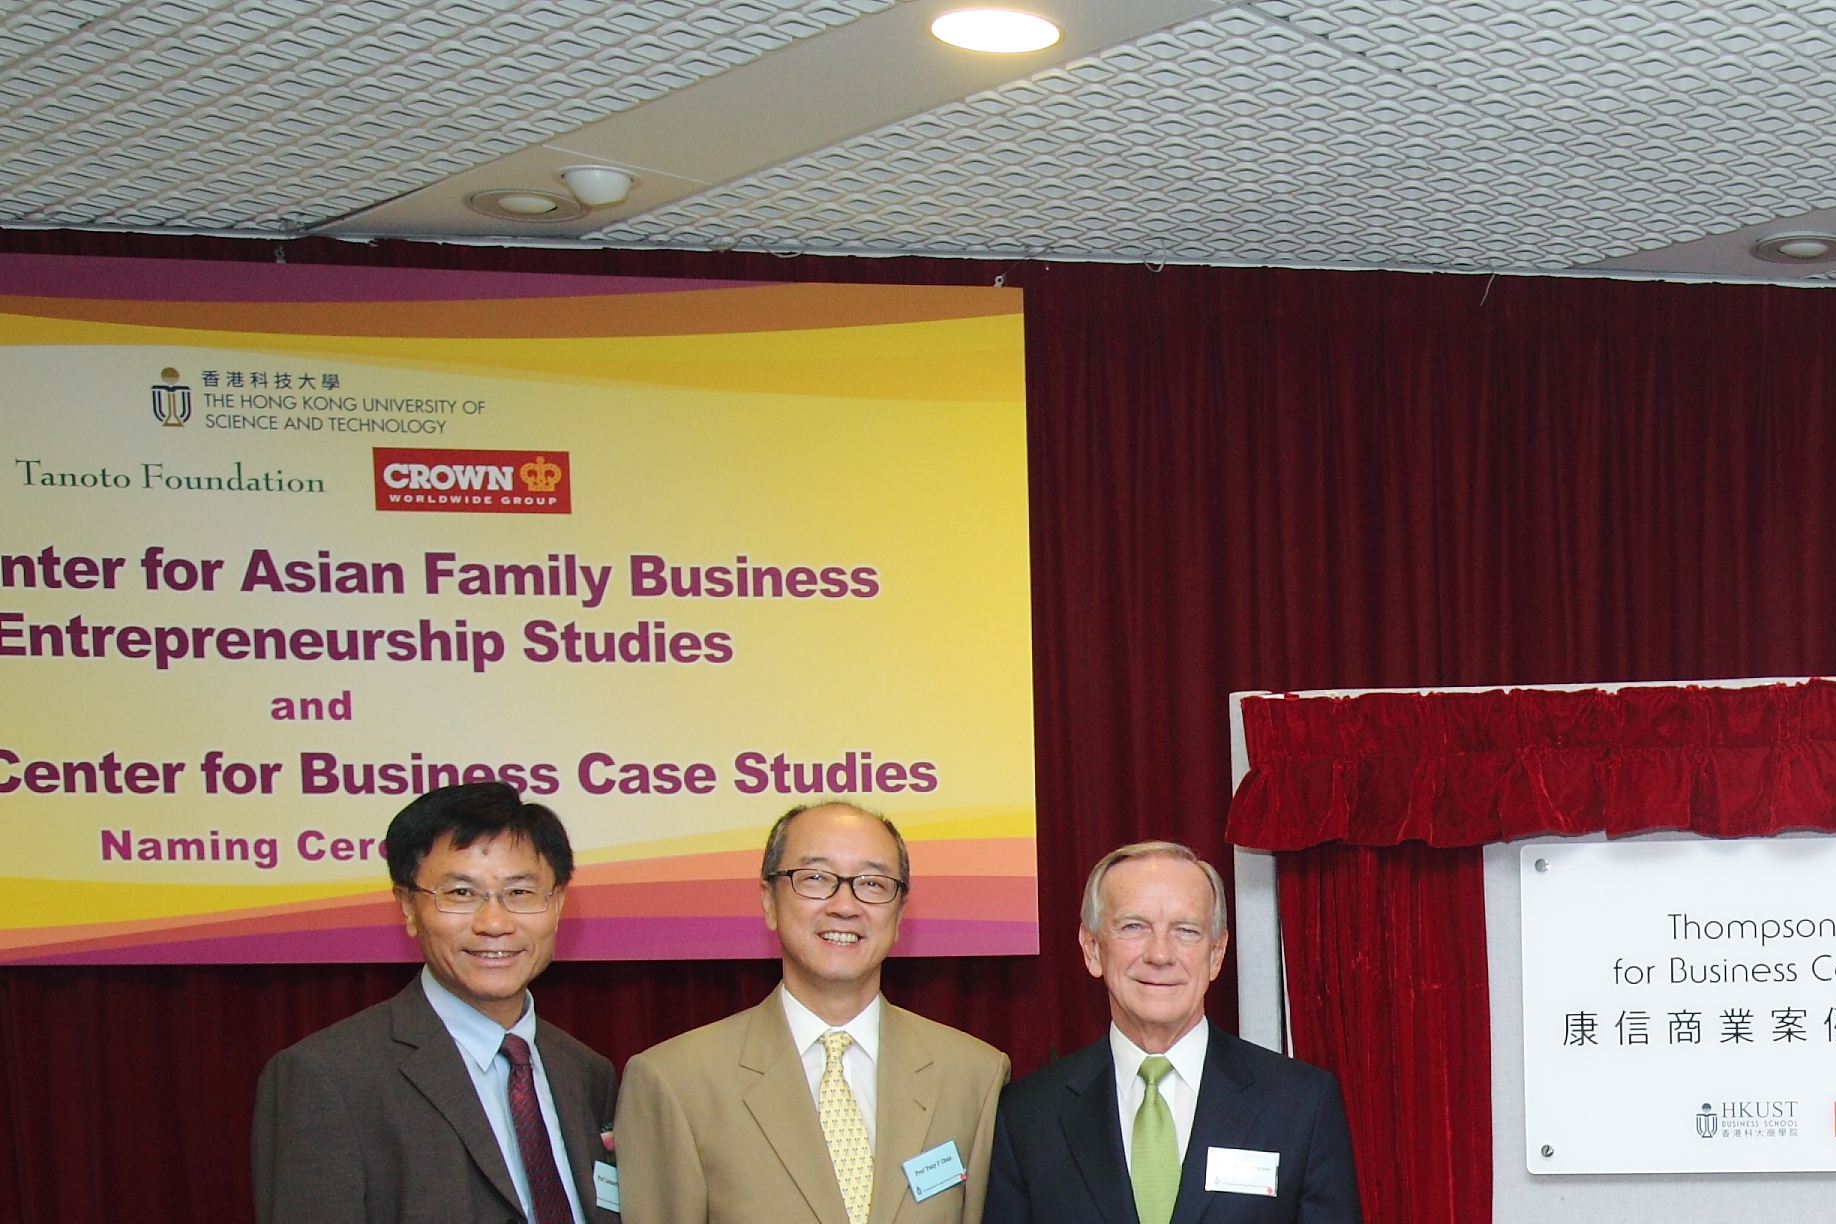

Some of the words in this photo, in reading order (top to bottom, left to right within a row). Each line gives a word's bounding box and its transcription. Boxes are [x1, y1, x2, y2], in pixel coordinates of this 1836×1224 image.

[202, 370, 340, 391] 香港科技大學
[203, 393, 234, 408] THE
[241, 394, 297, 410] HONG
[303, 396, 357, 412] KONG
[362, 398, 456, 414] UNIVERSITY
[464, 400, 485, 414] OF
[206, 414, 278, 430] SCIENCE
[284, 416, 323, 432] AND
[328, 418, 446, 434] TECHNOLOGY
[15, 459, 131, 489] Tanoto
[141, 462, 326, 494] Foundation
[383, 462, 514, 491] CROWN
[389, 494, 493, 505] WORLDWIDE
[501, 496, 557, 505] GROUP
[142, 546, 224, 592] for
[241, 549, 404, 595] Asian
[425, 552, 612, 607] Family
[630, 555, 880, 599] Business
[0, 612, 505, 674] Entrepreneurship
[523, 620, 733, 664] Studies
[270, 690, 353, 722] and
[202, 750, 283, 794] for
[301, 753, 560, 796] Business
[578, 752, 717, 796] Case
[734, 752, 938, 794] Studies
[100, 829, 280, 870] Naming
[1668, 911, 1836, 946] Thompson
[1613, 957, 1656, 986] for
[1669, 956, 1798, 984] Business
[1721, 1101, 1798, 1118] HKUST
